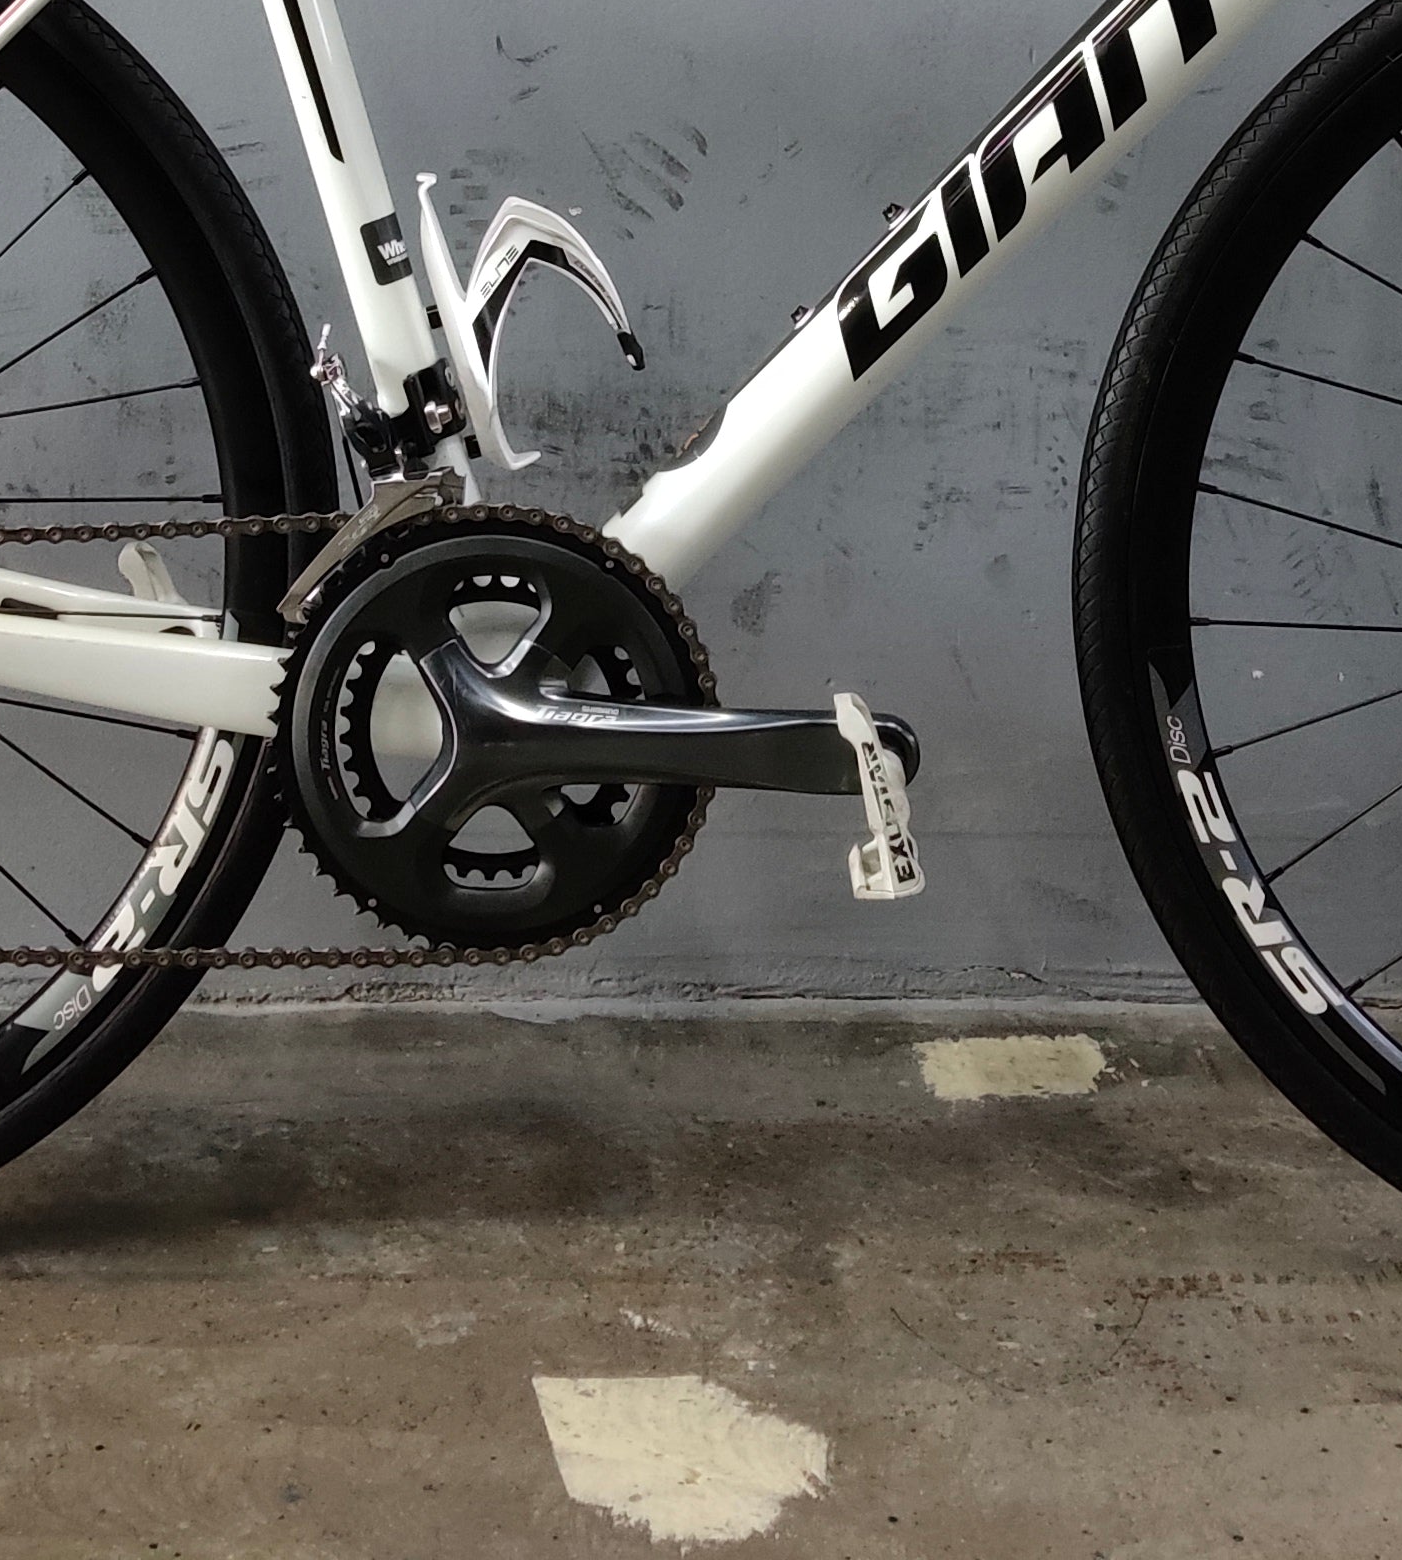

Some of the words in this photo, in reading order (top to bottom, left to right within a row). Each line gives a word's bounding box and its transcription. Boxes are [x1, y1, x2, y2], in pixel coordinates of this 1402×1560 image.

[537, 704, 617, 726] Tiagra
[1167, 715, 1192, 765] Disc
[91, 725, 235, 992] SR-2
[1177, 769, 1345, 1015] SR-2
[53, 983, 92, 1030] Disc
